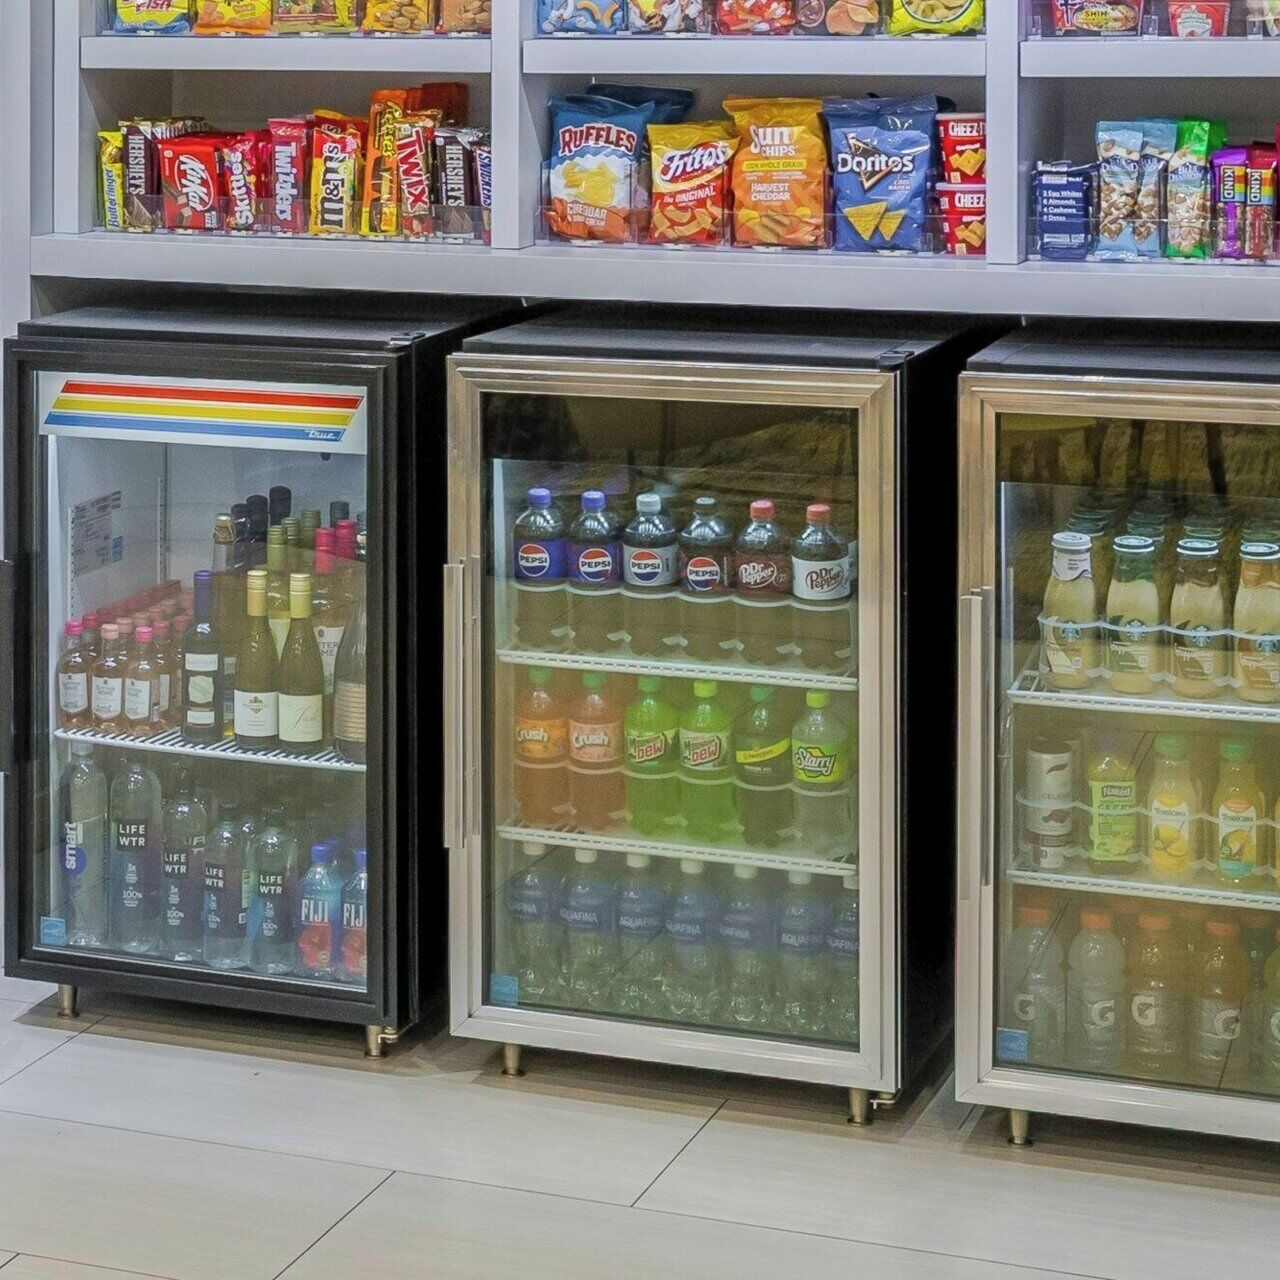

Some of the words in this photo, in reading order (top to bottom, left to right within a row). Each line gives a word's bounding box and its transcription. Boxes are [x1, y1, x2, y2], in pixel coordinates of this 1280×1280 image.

[559, 123, 638, 156] RUFFLES
[128, 135, 145, 196] HERSHEY'S
[397, 128, 429, 213] TWIX
[662, 141, 726, 180] Fritos
[782, 160, 804, 169] GRAIN
[837, 153, 915, 173] Doritos
[446, 145, 465, 207] HERSHEY'S
[1223, 167, 1233, 198] KIND
[231, 151, 254, 225] Skittles
[1251, 171, 1261, 202] KIND
[104, 168, 120, 228] Butterfinger
[519, 555, 547, 564] PEPSI
[581, 560, 611, 568] PEPSI
[631, 561, 660, 570] PEPSI
[739, 563, 776, 584] Pepper
[805, 570, 842, 590] Pepper
[572, 731, 609, 748] Crush
[796, 748, 836, 775] Starry
[1102, 786, 1131, 797] Naked
[119, 824, 145, 834] LIFE
[65, 821, 76, 870] smart
[119, 836, 145, 847] WTR
[165, 853, 186, 862] LIFE
[165, 865, 187, 873] WTR
[205, 867, 224, 877] LIFE
[260, 874, 283, 884] LIFE
[205, 878, 224, 888] WTR
[260, 886, 283, 894] WTR
[301, 899, 329, 923] FIJI
[1132, 995, 1156, 1026] G
